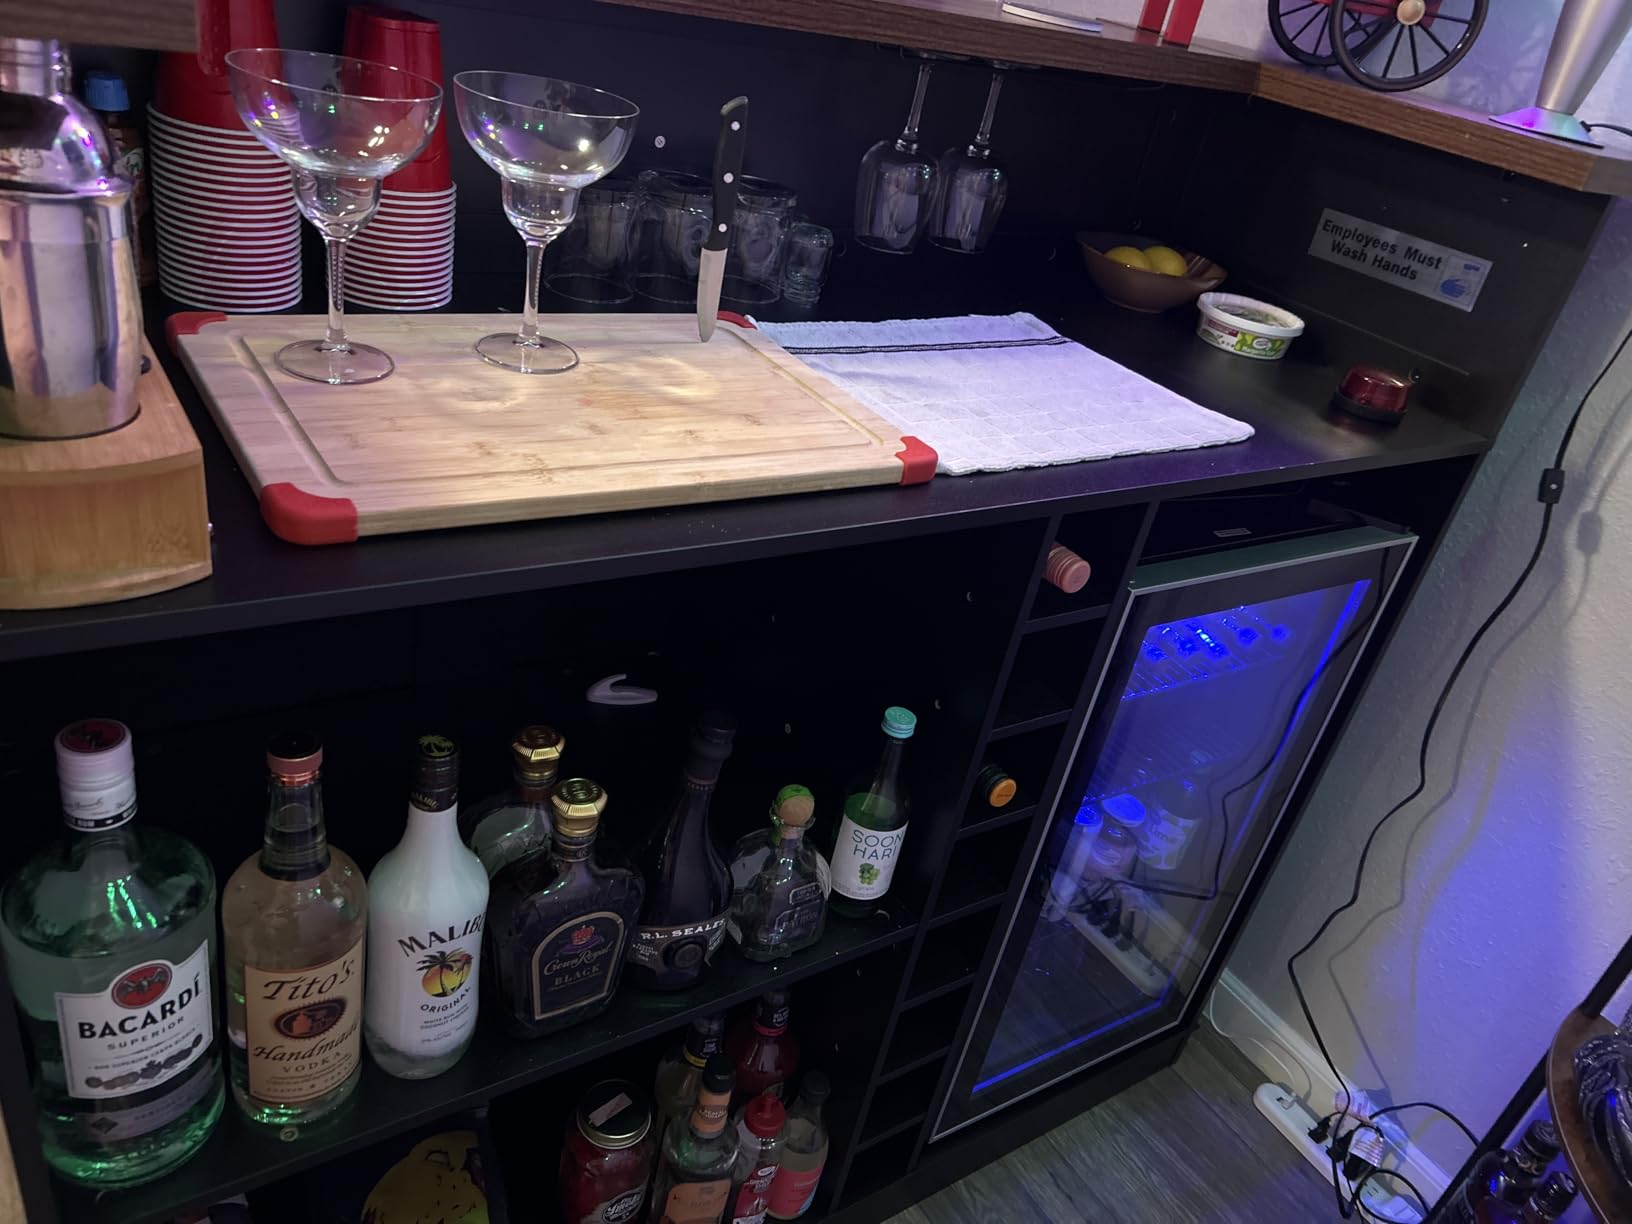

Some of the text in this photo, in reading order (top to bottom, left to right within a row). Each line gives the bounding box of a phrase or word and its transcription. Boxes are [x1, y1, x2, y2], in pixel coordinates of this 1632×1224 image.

[1322, 219, 1443, 270] Employees Must
[1331, 240, 1418, 281] Wash Hands
[853, 844, 897, 860] HARI
[640, 931, 668, 940] R.L.
[262, 959, 355, 1000] Tito's
[554, 963, 601, 986] BLACK
[78, 973, 202, 1040] BACARDÍ
[420, 986, 472, 1013] ORIGINAL
[106, 1016, 185, 1051] SUPERIOR
[282, 1051, 341, 1073] VODKA
